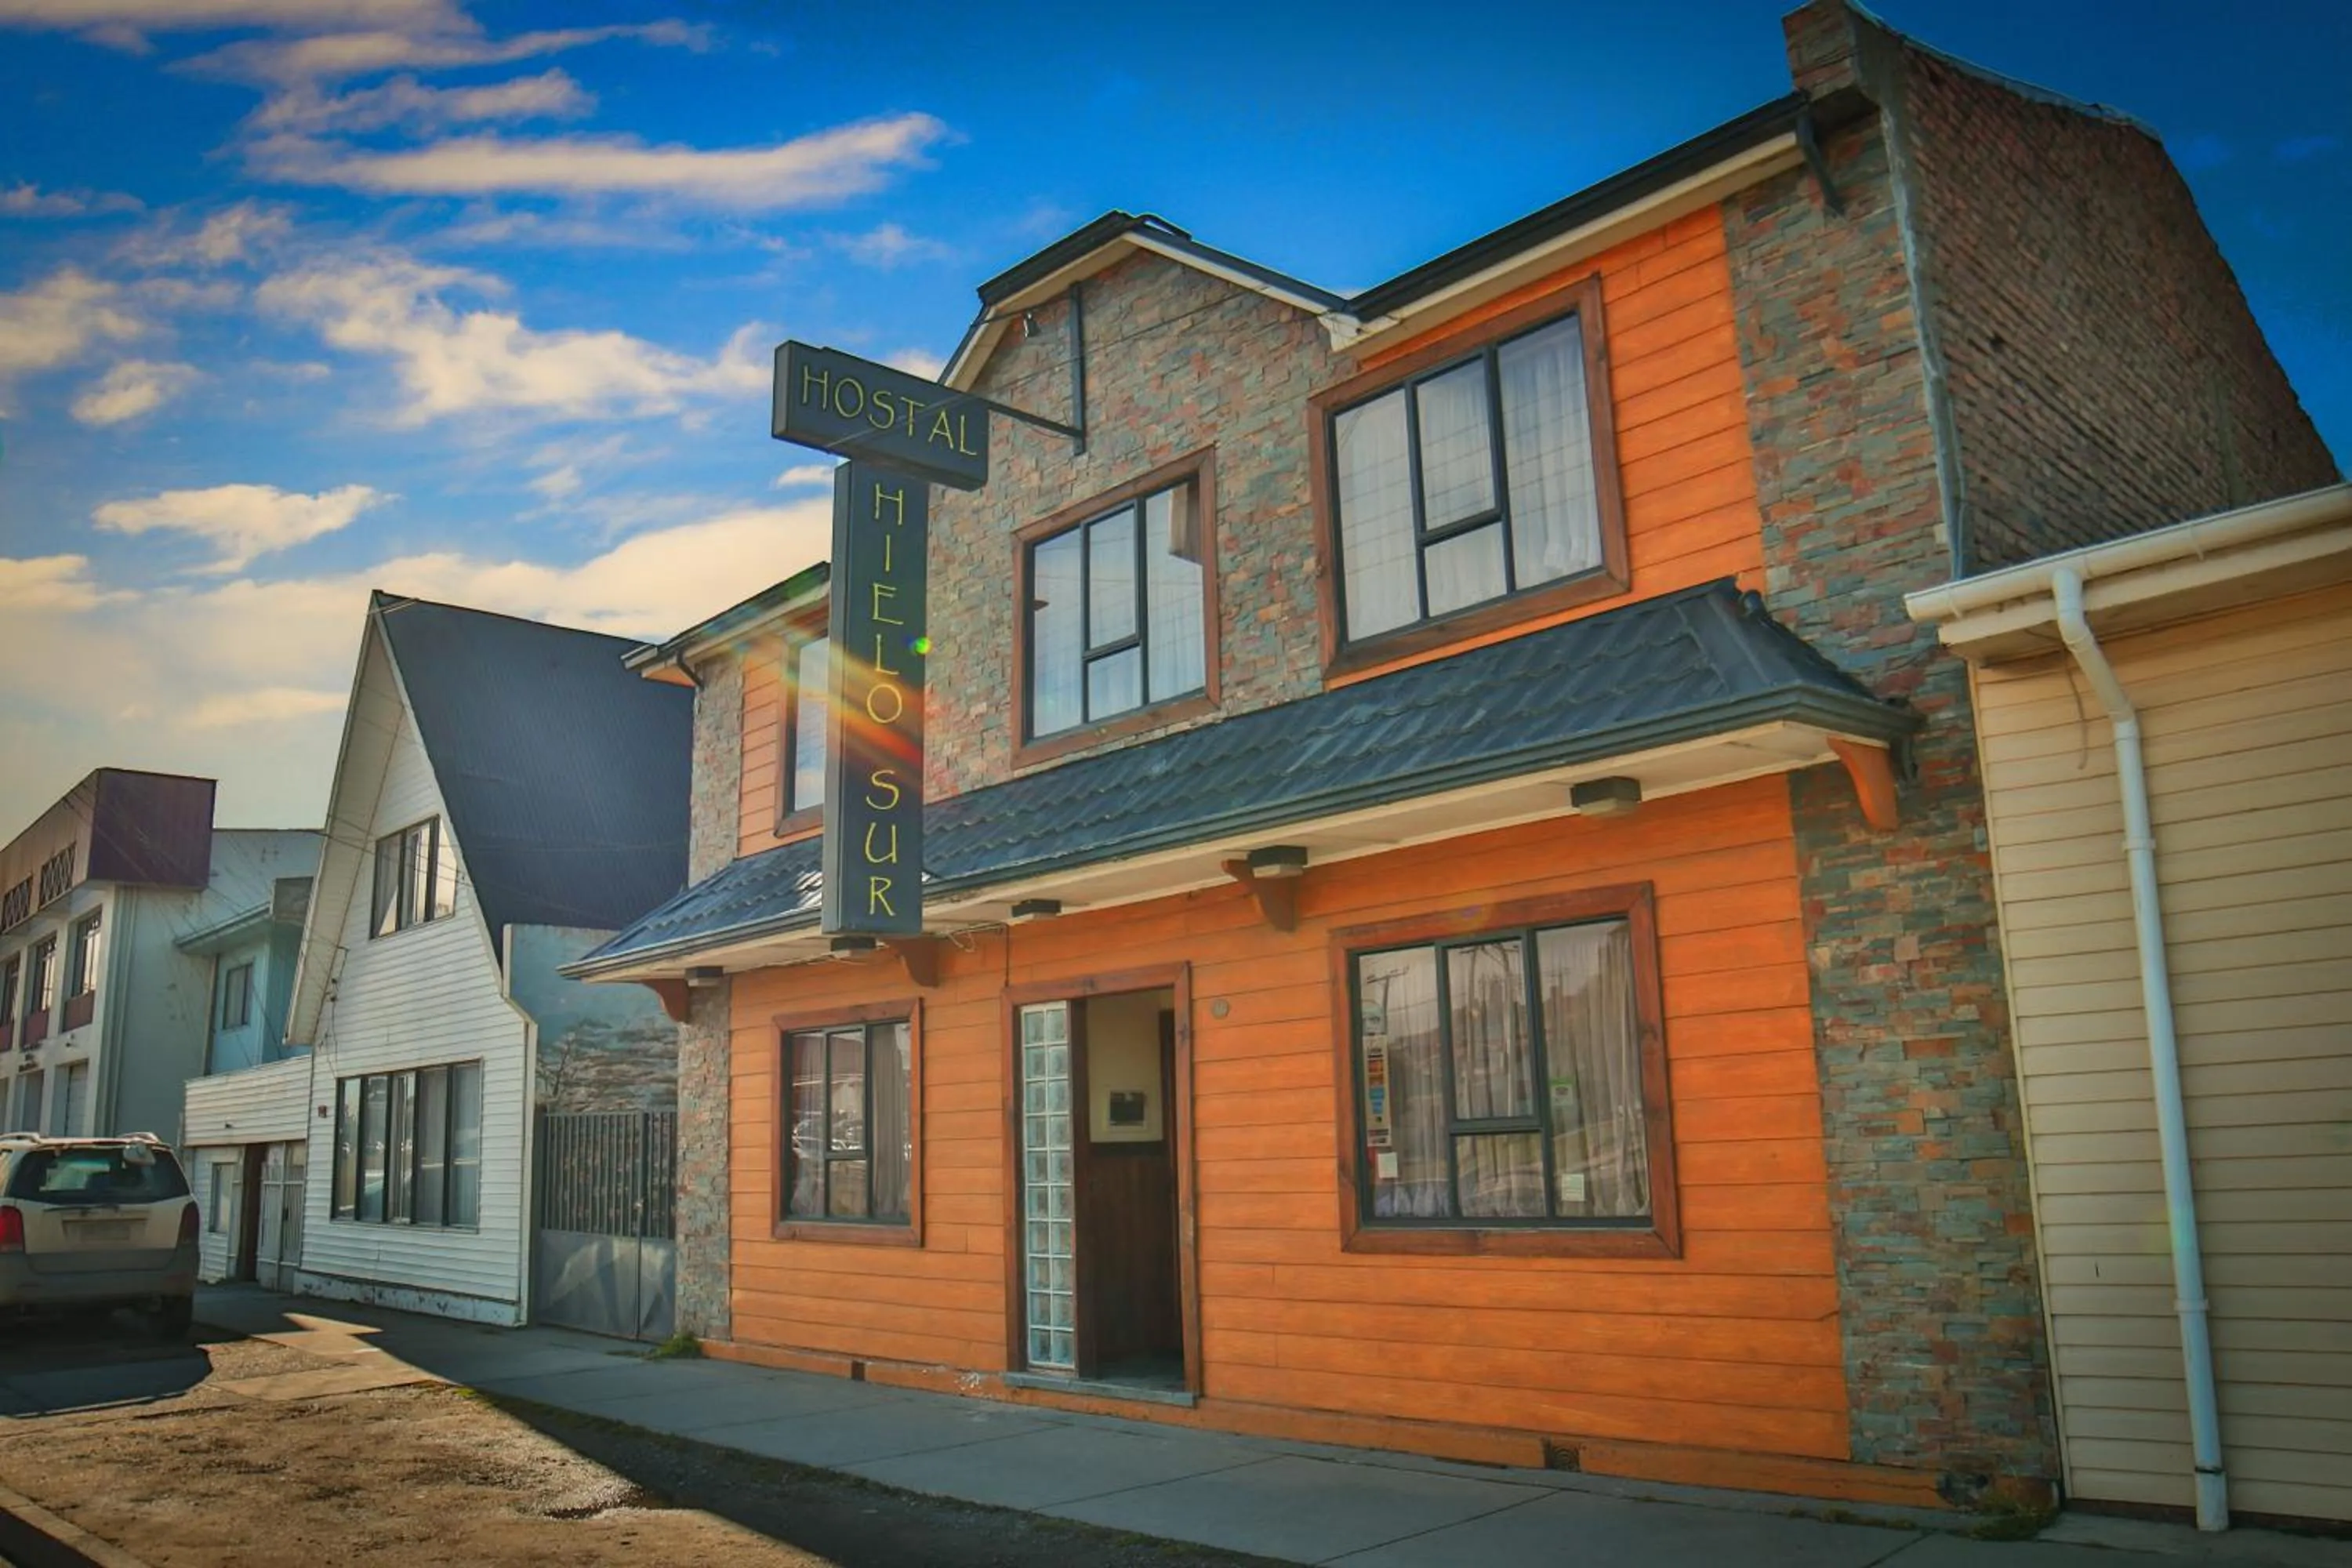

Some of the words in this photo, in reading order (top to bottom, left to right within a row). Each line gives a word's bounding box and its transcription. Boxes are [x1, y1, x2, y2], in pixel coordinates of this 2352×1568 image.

[802, 365, 978, 456] HOSTAL
[866, 483, 904, 723] HIELO
[865, 769, 900, 916] SUR
